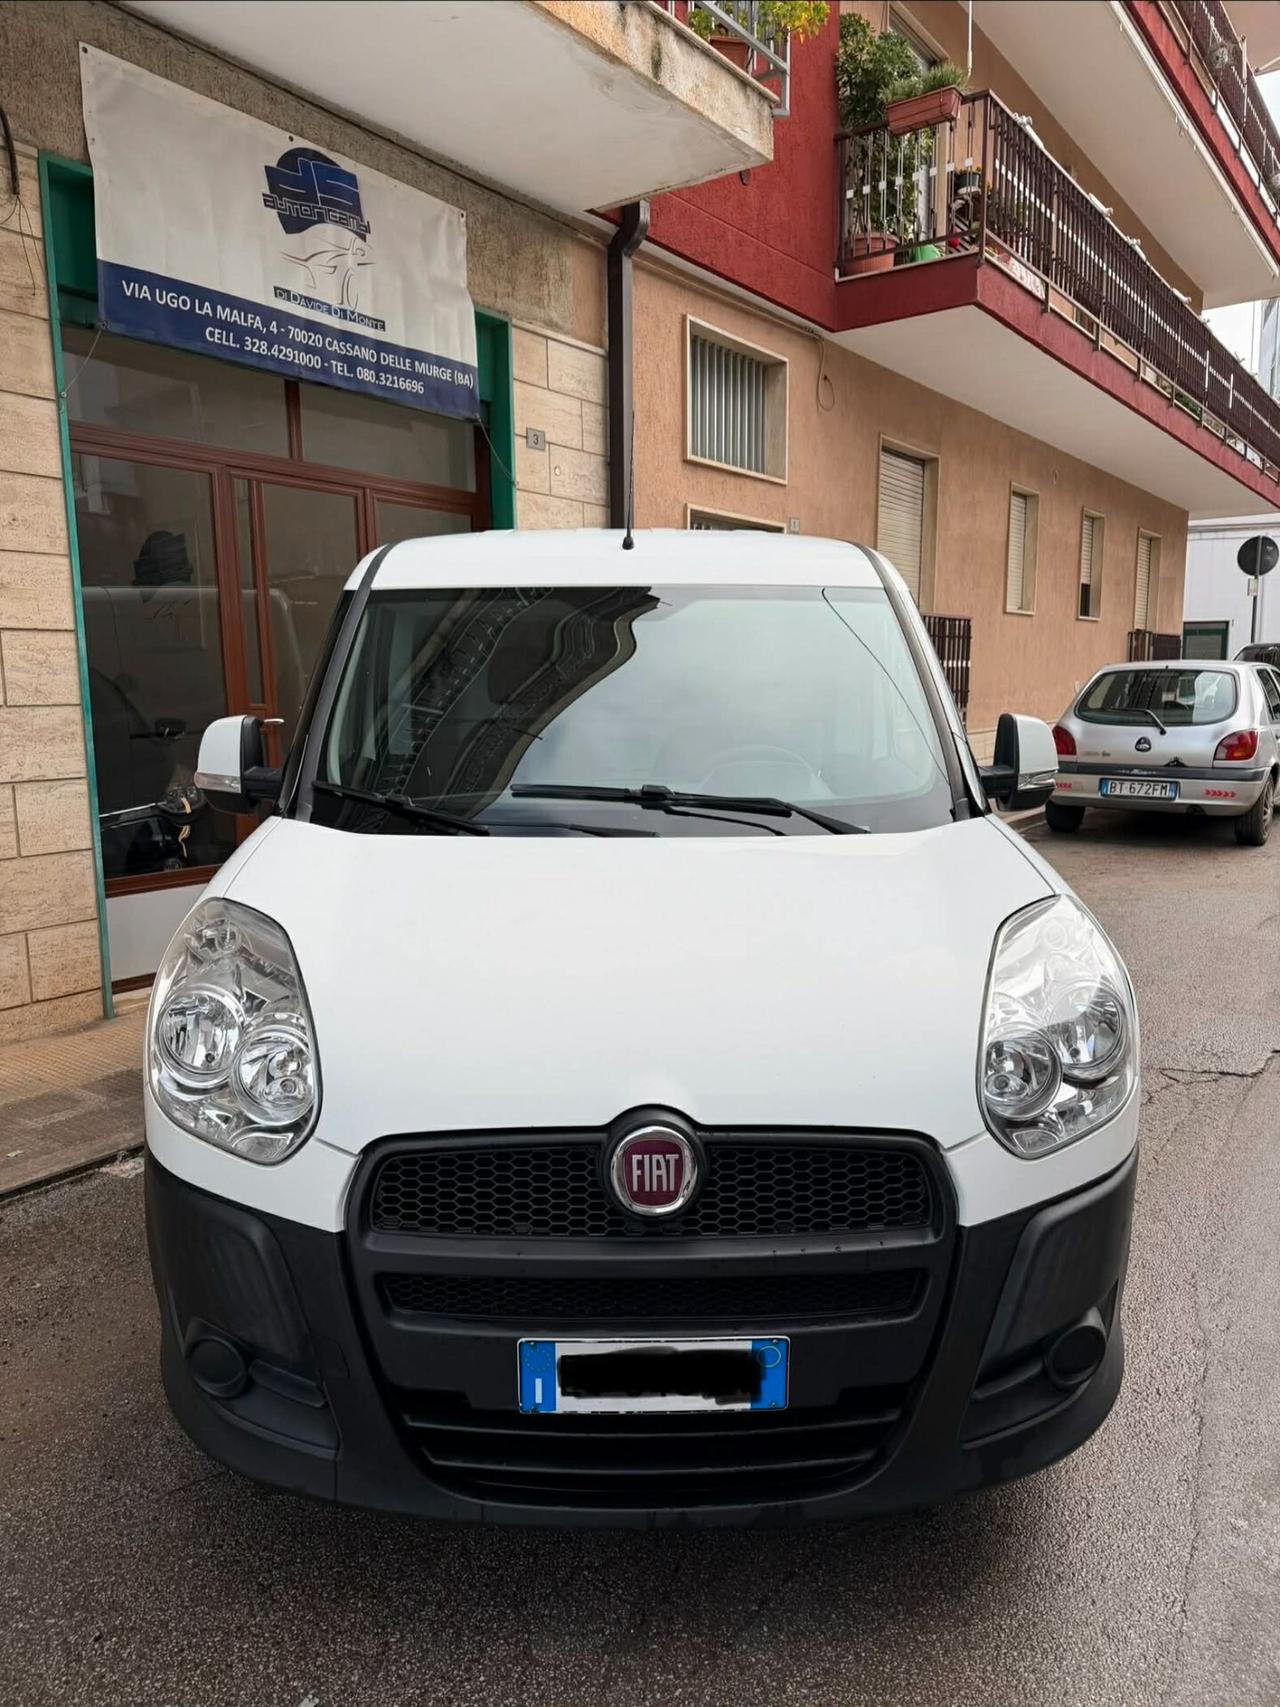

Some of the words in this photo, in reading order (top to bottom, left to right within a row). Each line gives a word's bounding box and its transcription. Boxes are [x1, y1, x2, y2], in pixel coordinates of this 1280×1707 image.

[121, 279, 152, 301] VIA
[155, 288, 191, 311] UGO
[195, 299, 213, 317] LA
[216, 305, 267, 334] MALFA,
[269, 320, 278, 335] 4
[287, 325, 323, 348] 70020
[325, 337, 377, 362] CASSANO
[380, 352, 412, 371] DELLE
[415, 360, 452, 382] MURGE
[454, 370, 474, 389] (BA)
[205, 326, 240, 348] CELL.
[243, 336, 322, 369] 328.4291000
[330, 360, 354, 378] TEL.
[356, 366, 425, 394] 080.3216696
[532, 433, 539, 446] 3
[1109, 782, 1124, 794] BT
[1129, 782, 1168, 796] 672FM
[631, 1153, 680, 1193] FIAT
